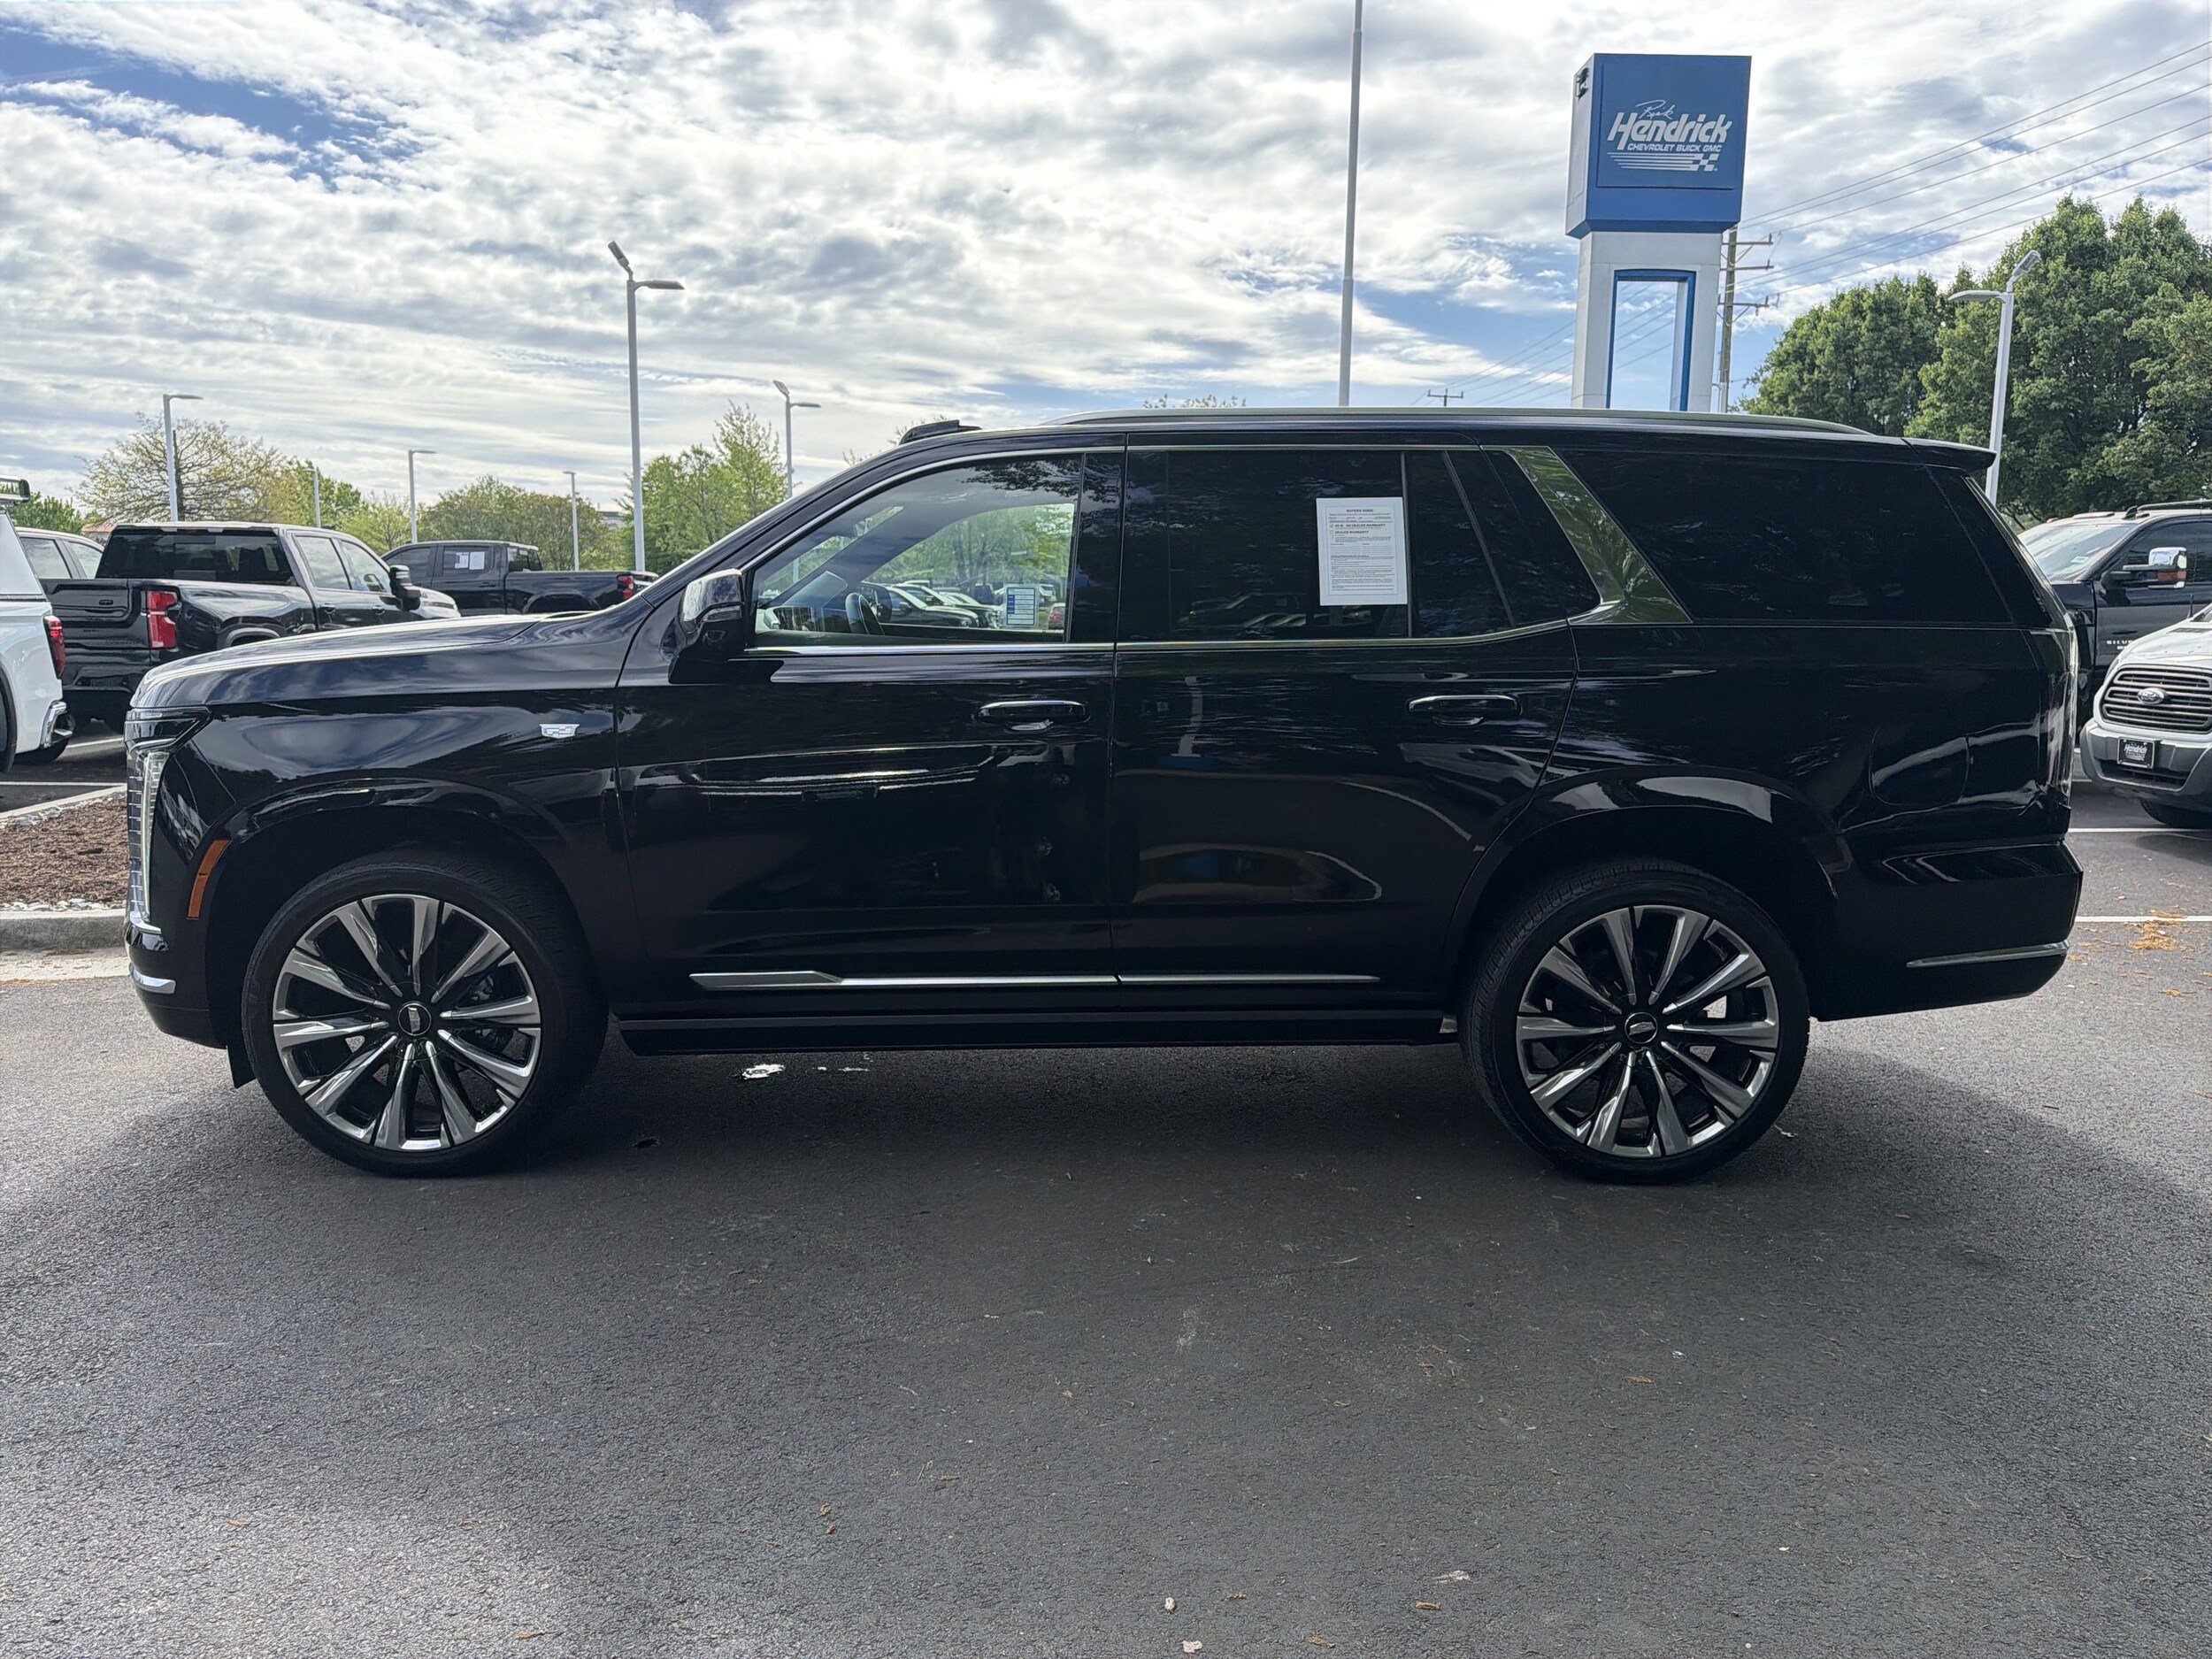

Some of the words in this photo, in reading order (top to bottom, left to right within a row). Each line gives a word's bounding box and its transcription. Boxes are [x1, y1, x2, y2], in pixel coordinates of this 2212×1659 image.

[1607, 112, 1732, 150] Hendrick
[1627, 142, 1675, 151] CHEVROLET
[1675, 143, 1701, 152] BUICK
[1702, 144, 1723, 153] GMC
[2124, 743, 2148, 754] Hendrick
